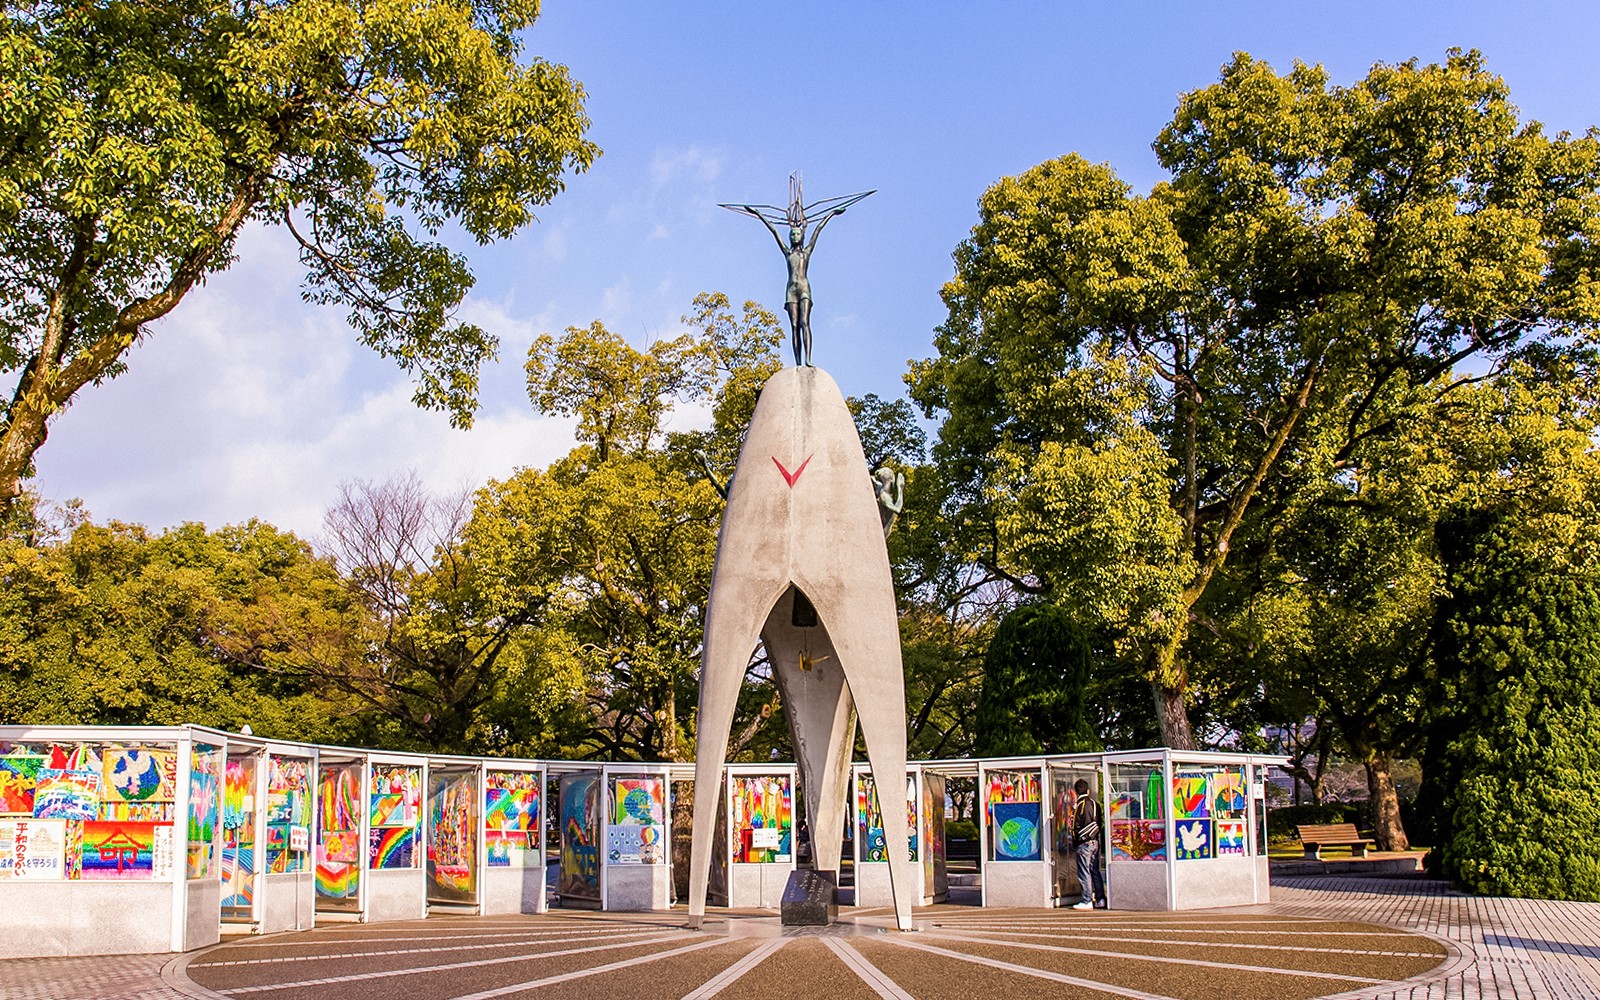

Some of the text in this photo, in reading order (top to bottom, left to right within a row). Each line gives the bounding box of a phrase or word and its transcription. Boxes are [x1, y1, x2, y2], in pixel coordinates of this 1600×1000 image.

[15, 822, 28, 876] 平和のちかい
[93, 827, 149, 876] 命
